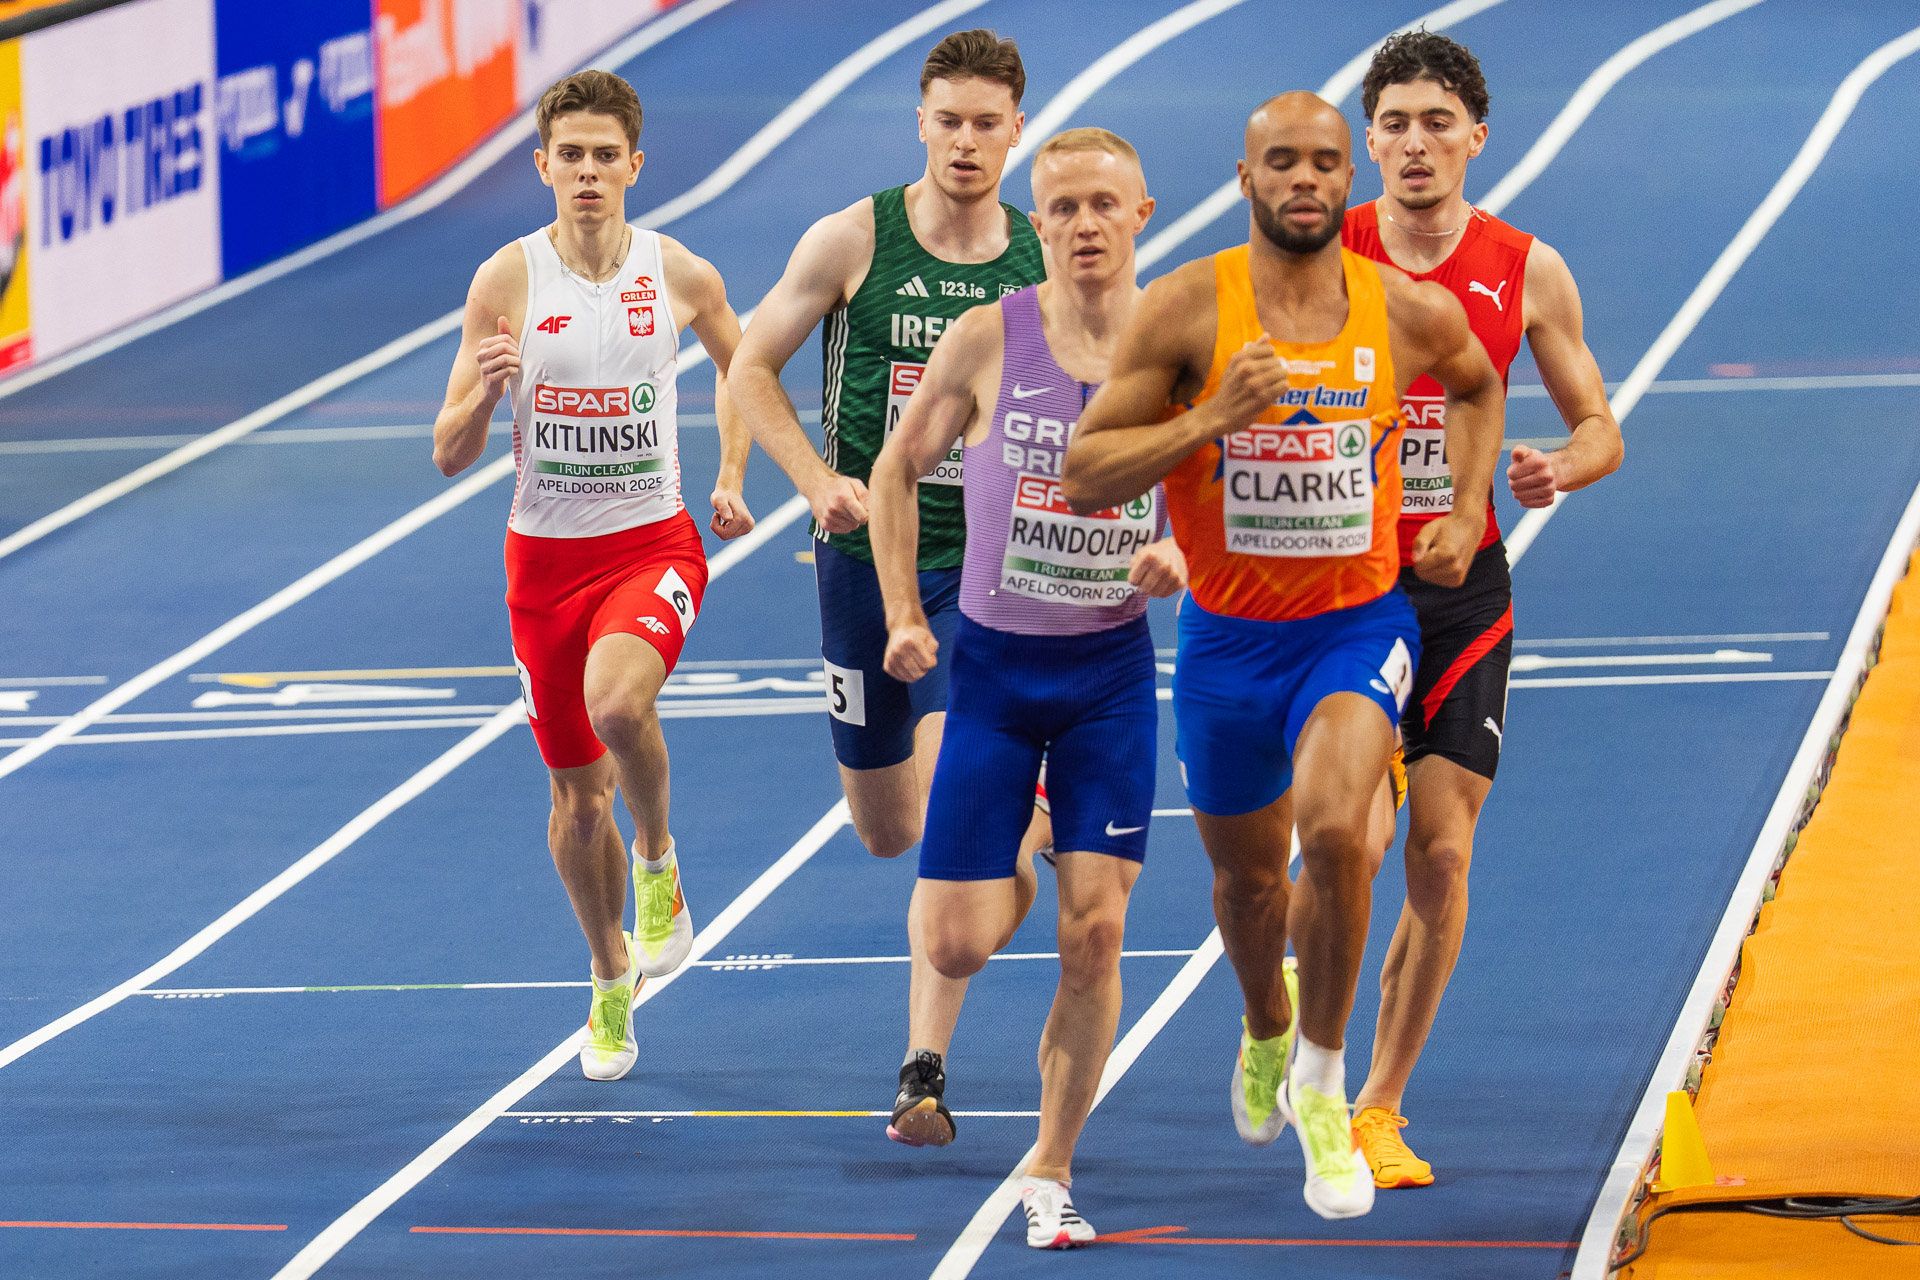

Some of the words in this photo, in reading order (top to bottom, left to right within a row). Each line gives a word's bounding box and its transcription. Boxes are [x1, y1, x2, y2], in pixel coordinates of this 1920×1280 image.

[622, 291, 655, 302] ORLEN
[939, 281, 986, 299] 123.ie
[537, 316, 572, 334] 4F
[891, 313, 955, 348] IRE
[537, 388, 628, 413] SPAR
[535, 420, 659, 453] KITLINSKI
[1230, 431, 1333, 458] SPAR
[565, 464, 591, 476] RUN
[537, 478, 626, 494] APELDOORN
[1231, 468, 1365, 503] CLARKE
[1263, 517, 1292, 529] RUN
[1011, 516, 1150, 557] RANDOLPH
[1231, 533, 1332, 550] APELDOORN
[1336, 532, 1367, 549] 2025
[1041, 563, 1071, 578] RUN
[1007, 576, 1103, 600] APELDOORN
[672, 590, 689, 616] 6
[636, 616, 670, 635] 4F
[831, 673, 848, 714] 5
